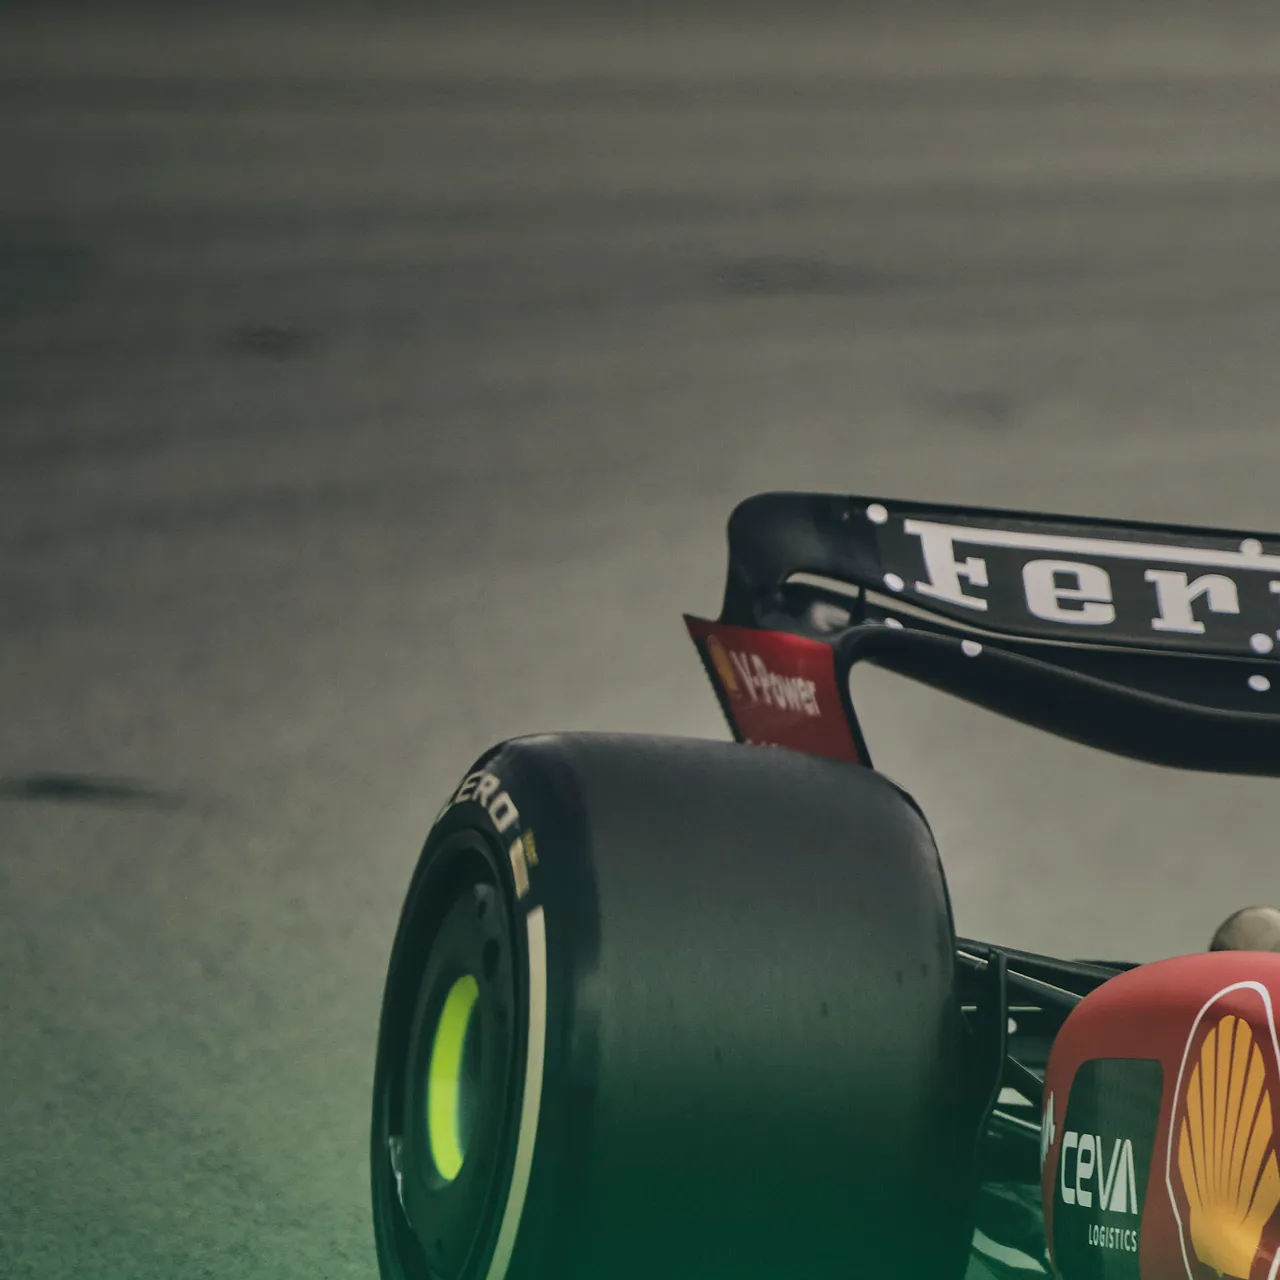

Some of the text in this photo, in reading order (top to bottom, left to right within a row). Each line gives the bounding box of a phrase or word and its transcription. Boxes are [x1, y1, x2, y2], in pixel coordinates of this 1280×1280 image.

[729, 650, 822, 717] V-Power
[445, 768, 520, 833] ERO
[1088, 1223, 1138, 1253] LOGISTICS
